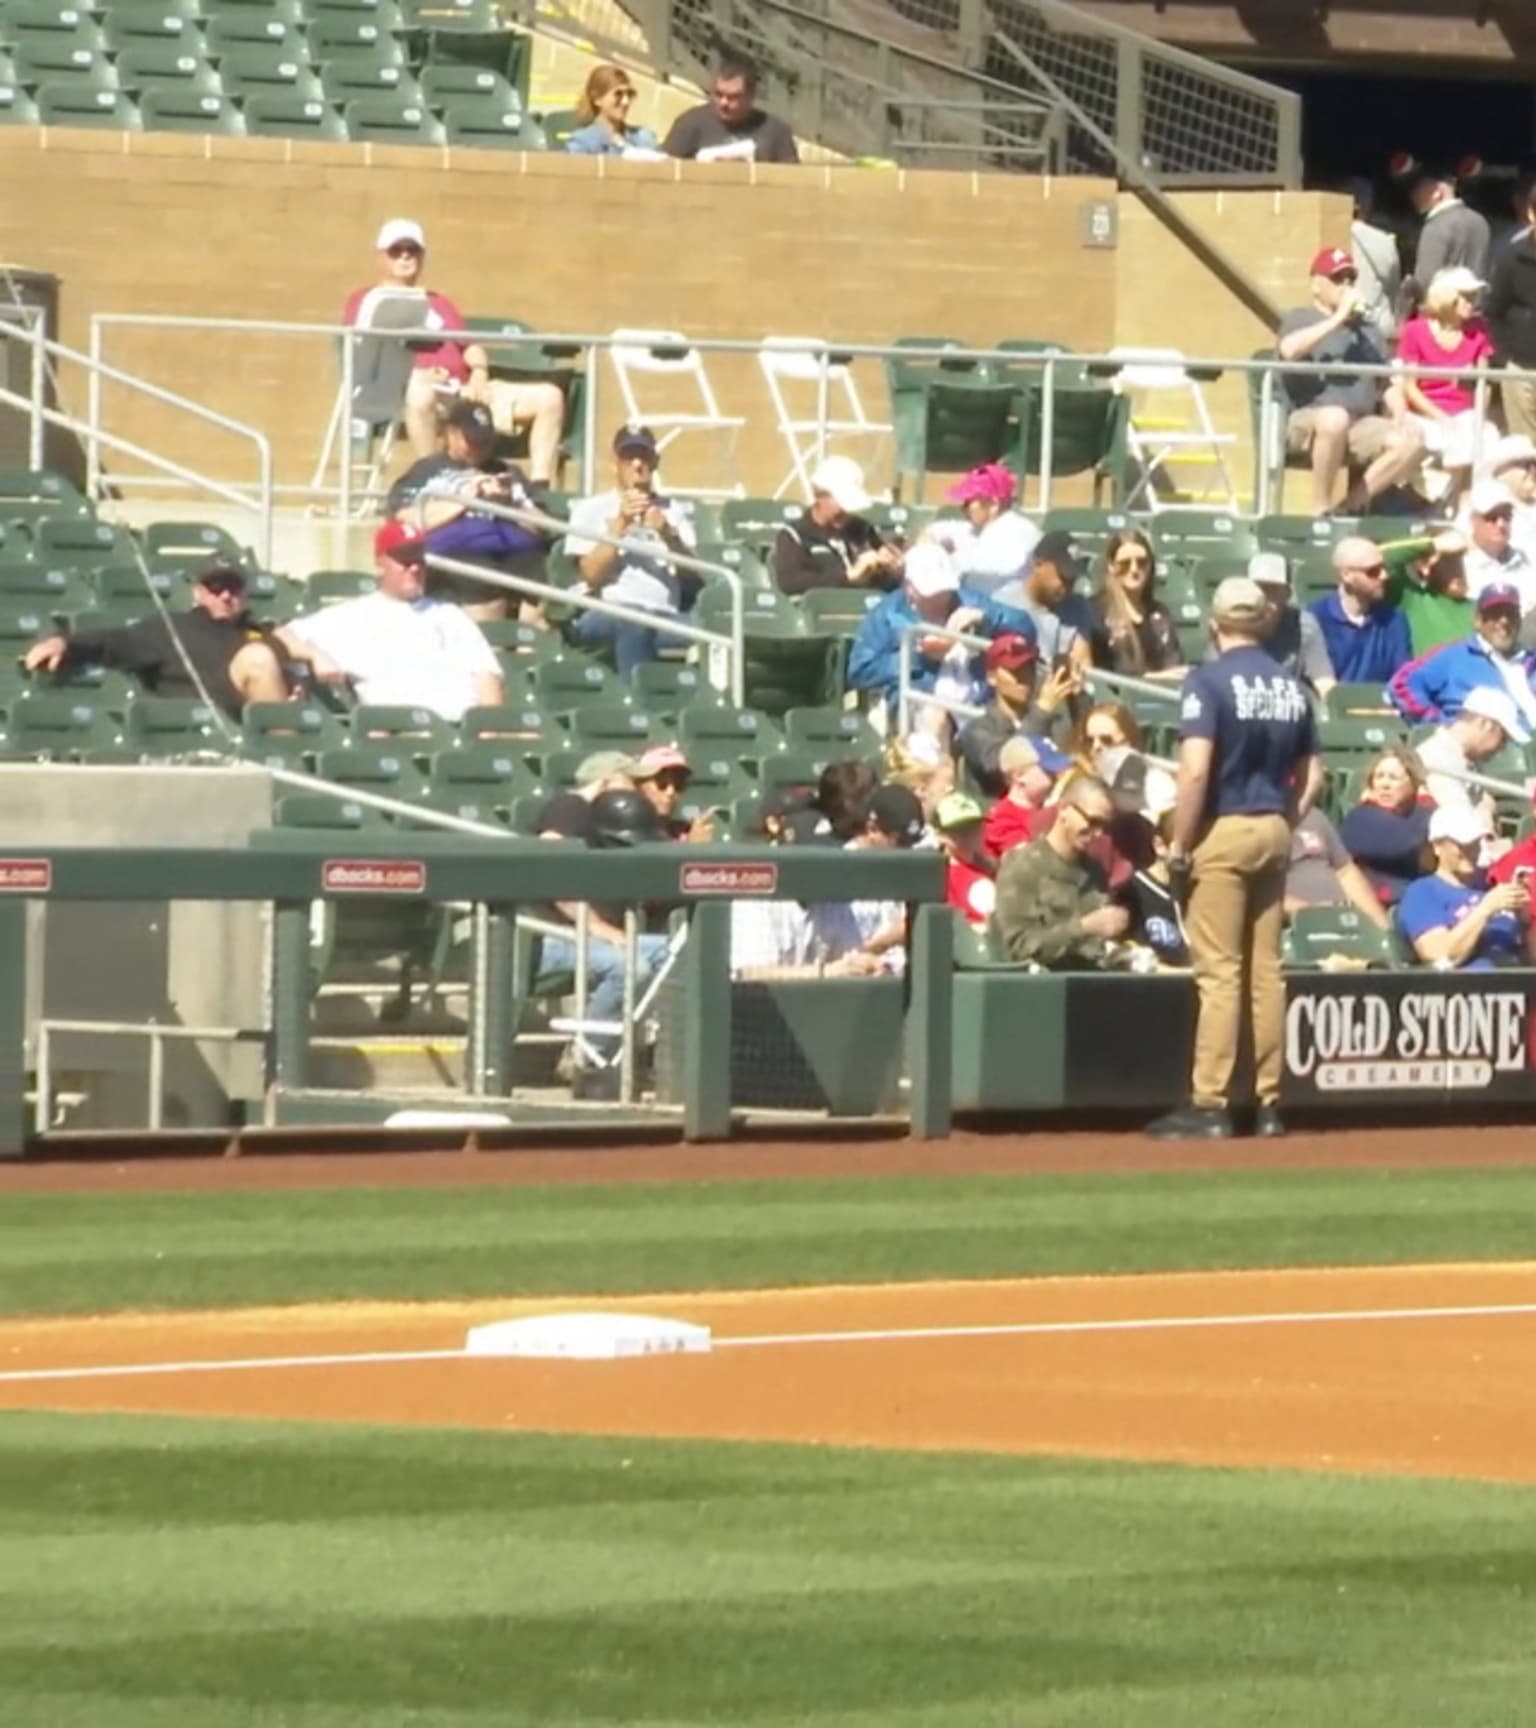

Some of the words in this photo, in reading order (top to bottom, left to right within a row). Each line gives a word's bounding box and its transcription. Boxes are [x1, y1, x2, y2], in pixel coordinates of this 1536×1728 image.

[1286, 993, 1391, 1076] COLD
[1396, 992, 1525, 1071] STONE
[1324, 1065, 1483, 1084] CREAMERY
